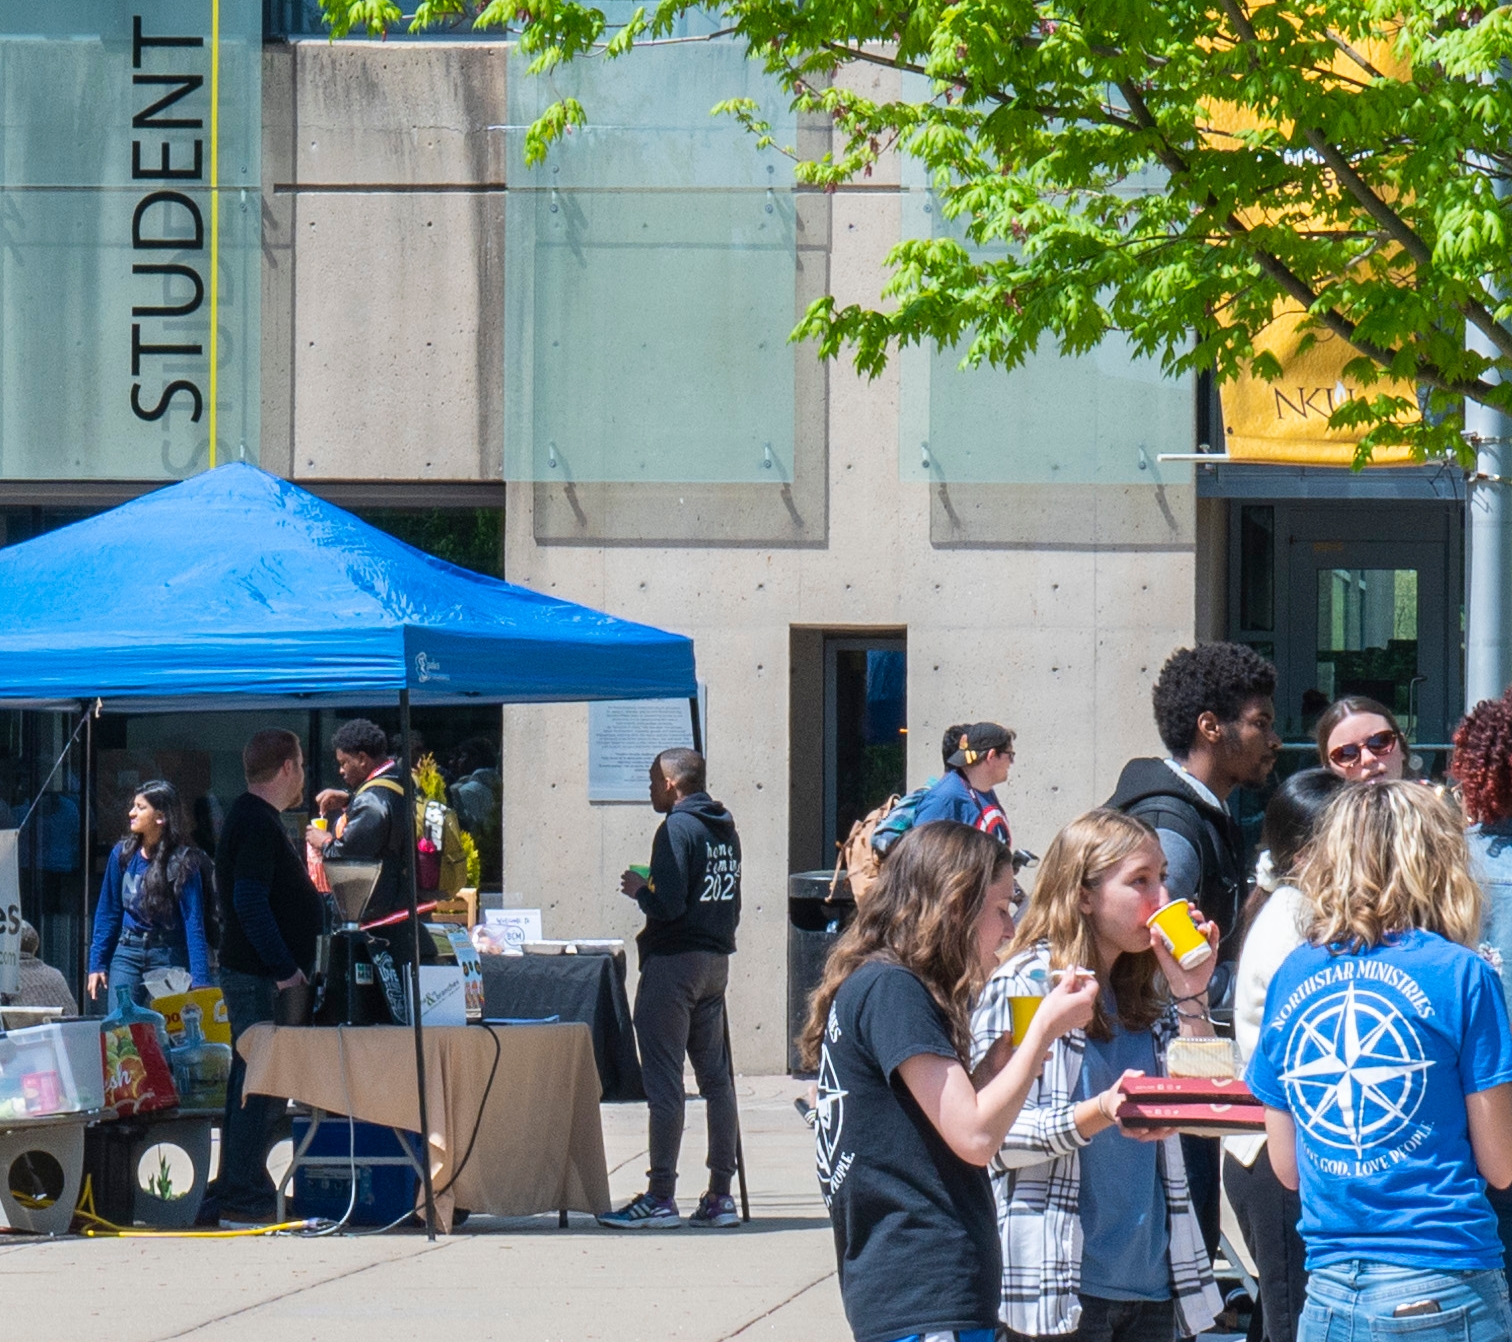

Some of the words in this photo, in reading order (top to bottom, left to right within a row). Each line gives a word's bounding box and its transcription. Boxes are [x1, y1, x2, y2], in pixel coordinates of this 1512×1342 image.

[130, 15, 205, 424] STUDENT
[1271, 961, 1355, 1032] NORTHSTAR
[1356, 959, 1436, 1020] MINISTRIES
[1355, 1154, 1390, 1177] LOVE
